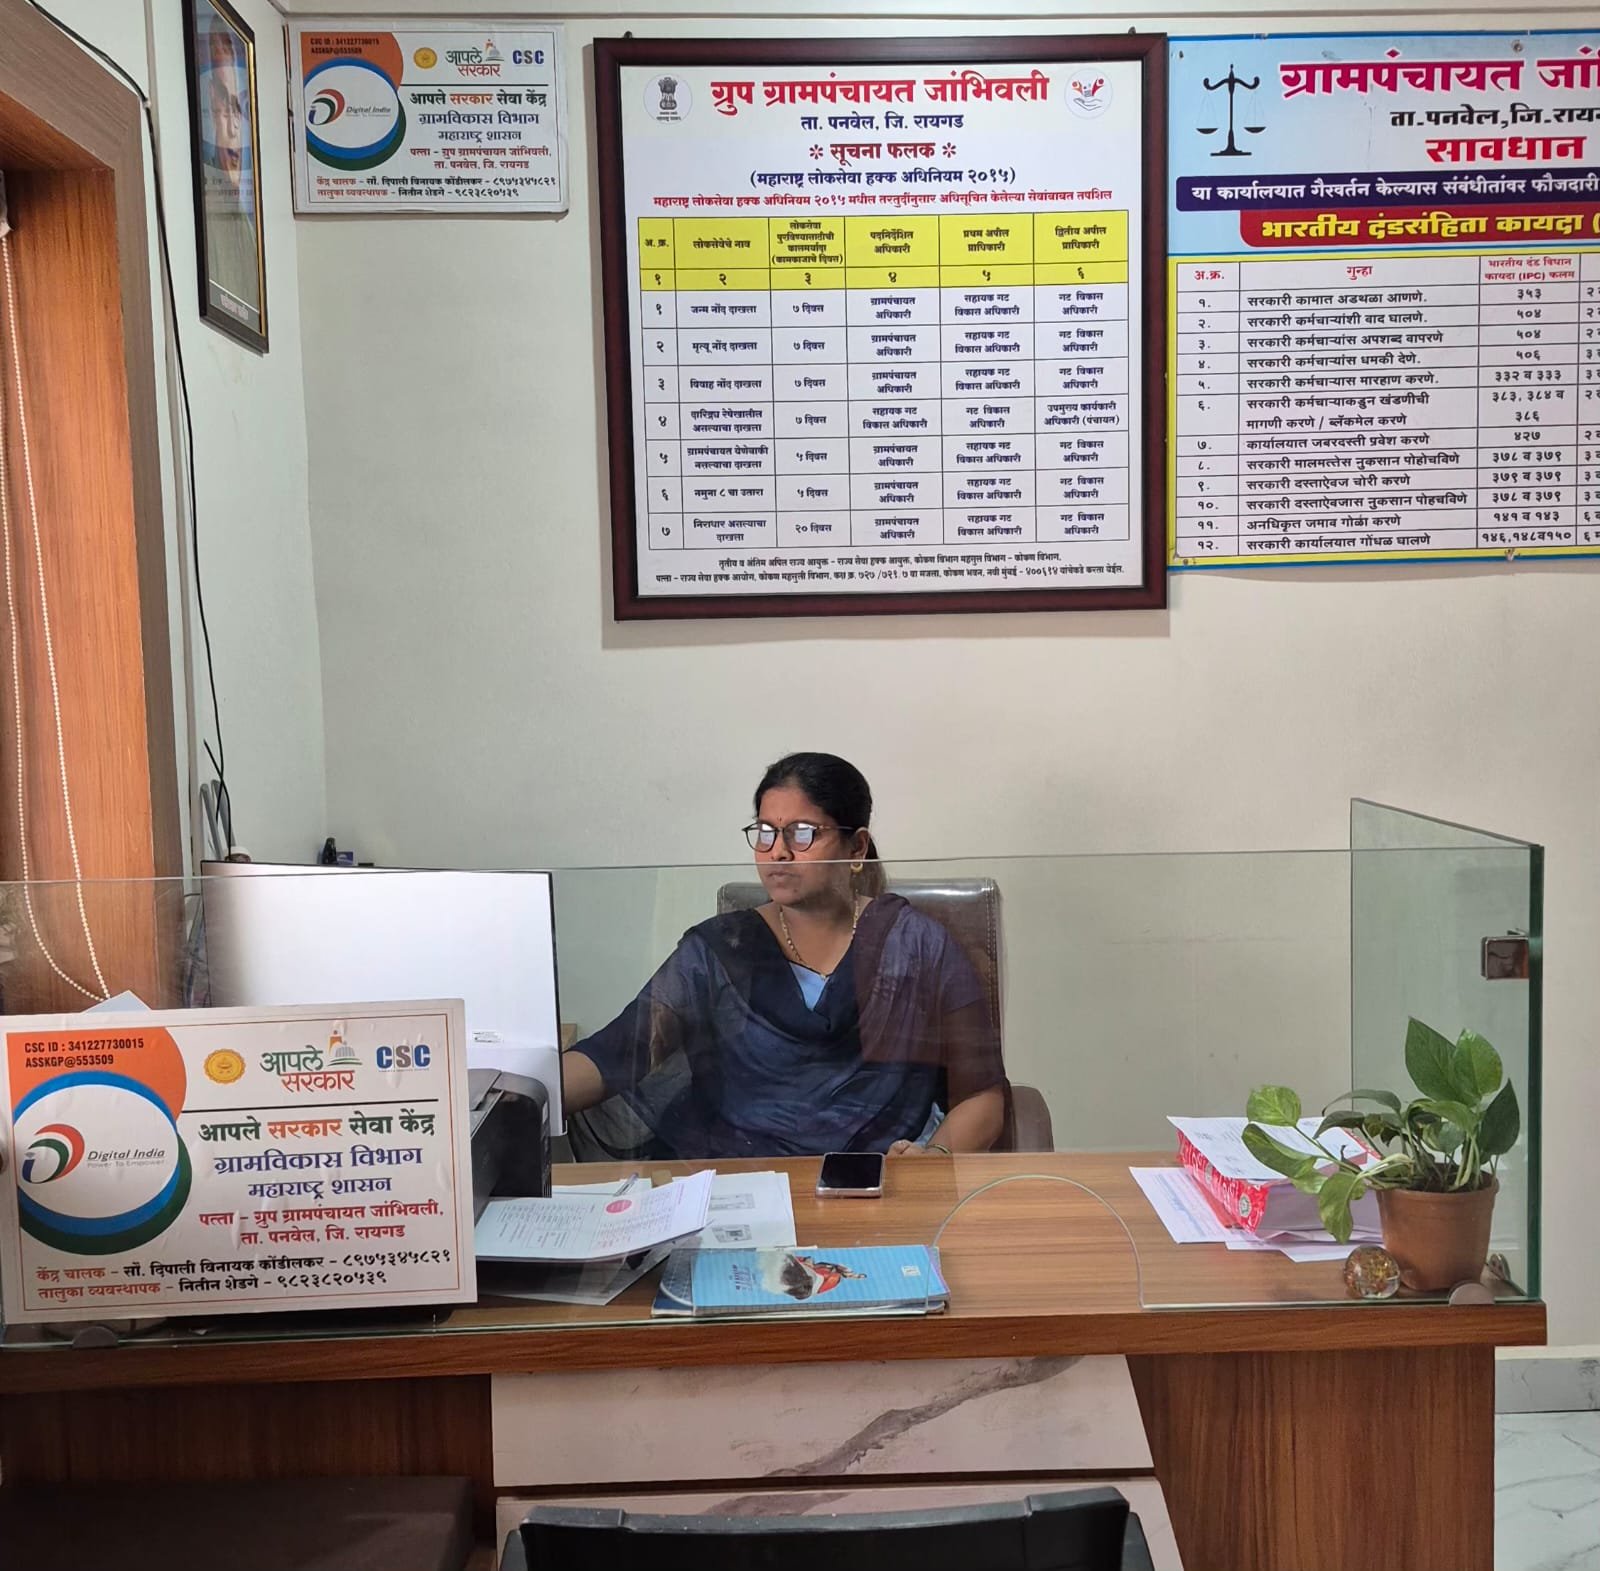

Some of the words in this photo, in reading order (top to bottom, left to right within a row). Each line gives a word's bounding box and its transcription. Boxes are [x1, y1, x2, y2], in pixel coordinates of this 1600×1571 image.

[512, 50, 544, 64] CSC
[1280, 49, 1524, 98] ग्रामपंचायत
[410, 89, 446, 104] आपले
[450, 94, 493, 104] सरकार
[496, 89, 522, 104] सेवा
[526, 89, 546, 107] केंद्र
[710, 82, 755, 116] ग्रुप
[763, 73, 916, 112] ग्रामपंचायत
[924, 69, 1050, 102] जांभिवली
[419, 110, 492, 124] ग्रामविकास
[498, 110, 538, 124] विभाग
[800, 117, 822, 130] ता.
[828, 112, 879, 130] पनवेल,
[884, 112, 908, 128] जि.
[914, 115, 964, 128] रायगड
[438, 131, 482, 143] महाराष्ट्र
[487, 131, 521, 140] शासन
[830, 143, 882, 167] सूचना
[887, 142, 936, 158] फलक
[1425, 136, 1587, 162] सावधान
[808, 168, 862, 184] लोकसेवा
[865, 172, 897, 186] हक्क
[901, 167, 963, 182] अधिनियम
[968, 167, 1015, 184] २०१५)
[1192, 187, 1212, 200] या
[1216, 182, 1306, 200] कार्यालयात
[1310, 179, 1370, 197] गैरवर्तन
[1375, 178, 1438, 196] केल्यास
[1442, 175, 1526, 194] संबंधीतांवर
[1532, 172, 1599, 193] फौजदारी
[1263, 216, 1360, 237] भारतीय
[1368, 214, 1488, 238] दंडसंहिता
[1496, 215, 1584, 234] कायदा
[1347, 266, 1373, 280] गुन्हा
[1248, 293, 1292, 306] सरकारी
[1296, 295, 1334, 305] कामात
[1338, 294, 1383, 304] अडथळा
[1387, 290, 1426, 302] आणणे.
[1518, 289, 1541, 300] ३५३
[1247, 314, 1292, 327] सरकारी
[1295, 312, 1362, 326] कर्मचाऱ्यांशी
[1364, 314, 1385, 324] वाद
[1388, 310, 1427, 323] घालणे.
[1517, 309, 1541, 319] ५०४
[1247, 334, 1292, 347] सरकारी
[1295, 334, 1357, 346] कर्मचाऱ्यांस
[1361, 334, 1402, 344] अपशब्द
[1406, 330, 1444, 343] वापरणे
[1517, 330, 1541, 339] ५०४
[1246, 396, 1291, 408] सरकारी
[1294, 395, 1376, 409] कर्मचाऱ्याकडुन
[1379, 392, 1430, 405] खंडणीची
[1246, 416, 1282, 429] मागणी
[1286, 416, 1315, 428] करणे
[1328, 414, 1374, 426] ब्लॅकमेल
[1378, 413, 1407, 425] करणे
[1246, 437, 1308, 449] कार्यालयात
[1312, 434, 1366, 447] जबरदस्ती
[1370, 434, 1397, 446] प्रवेश
[1400, 432, 1430, 445] करणे
[1246, 456, 1291, 469] सरकारी
[1294, 455, 1352, 468] मालमत्तेस
[1355, 456, 1400, 469] नुकसान
[1404, 452, 1460, 466] पोहोचविणे
[1246, 537, 1291, 550] सरकारी
[1294, 536, 1356, 548] कार्यालयात
[1360, 534, 1393, 546] गोंधळ
[1396, 533, 1431, 545] घालणे
[25, 1042, 44, 1053] CSC
[48, 1042, 58, 1052] ID
[68, 1038, 144, 1051] 341227730015
[26, 1054, 114, 1068] ASSKGP@553509
[260, 1045, 323, 1075] आपले
[376, 1045, 430, 1069] CSC
[281, 1070, 355, 1092] सरकार
[199, 1116, 261, 1142] आपले
[268, 1119, 342, 1139] सरकार
[348, 1112, 393, 1135] सेवा
[399, 1110, 435, 1136] केंद्र
[88, 1150, 130, 1162] Digital
[133, 1148, 164, 1159] India
[214, 1149, 343, 1174] ग्रामविकास
[350, 1145, 422, 1166] विभाग
[248, 1181, 324, 1199] महाराष्ट्र
[331, 1178, 392, 1194] शासन
[199, 1212, 234, 1225] पत्ता
[254, 1210, 278, 1227] ग्रुप
[282, 1204, 366, 1222] ग्रामपंचायत
[240, 1232, 262, 1244] ता.
[266, 1226, 320, 1243] पनवेल,
[325, 1224, 349, 1240] जि.
[354, 1225, 405, 1239] रायगड
[36, 1266, 60, 1282] केंद्र
[63, 1268, 105, 1279] चालक
[150, 1260, 196, 1277] दिपाली
[200, 1259, 254, 1273] विनायक
[258, 1255, 324, 1270] कोंडीलकर
[37, 1286, 84, 1301] तालुका
[88, 1283, 160, 1296] व्यवस्थापक
[178, 1277, 221, 1292] नितीन
[225, 1274, 258, 1290] शेडगे
[278, 1271, 386, 1288] ९८२३८२०५३९
